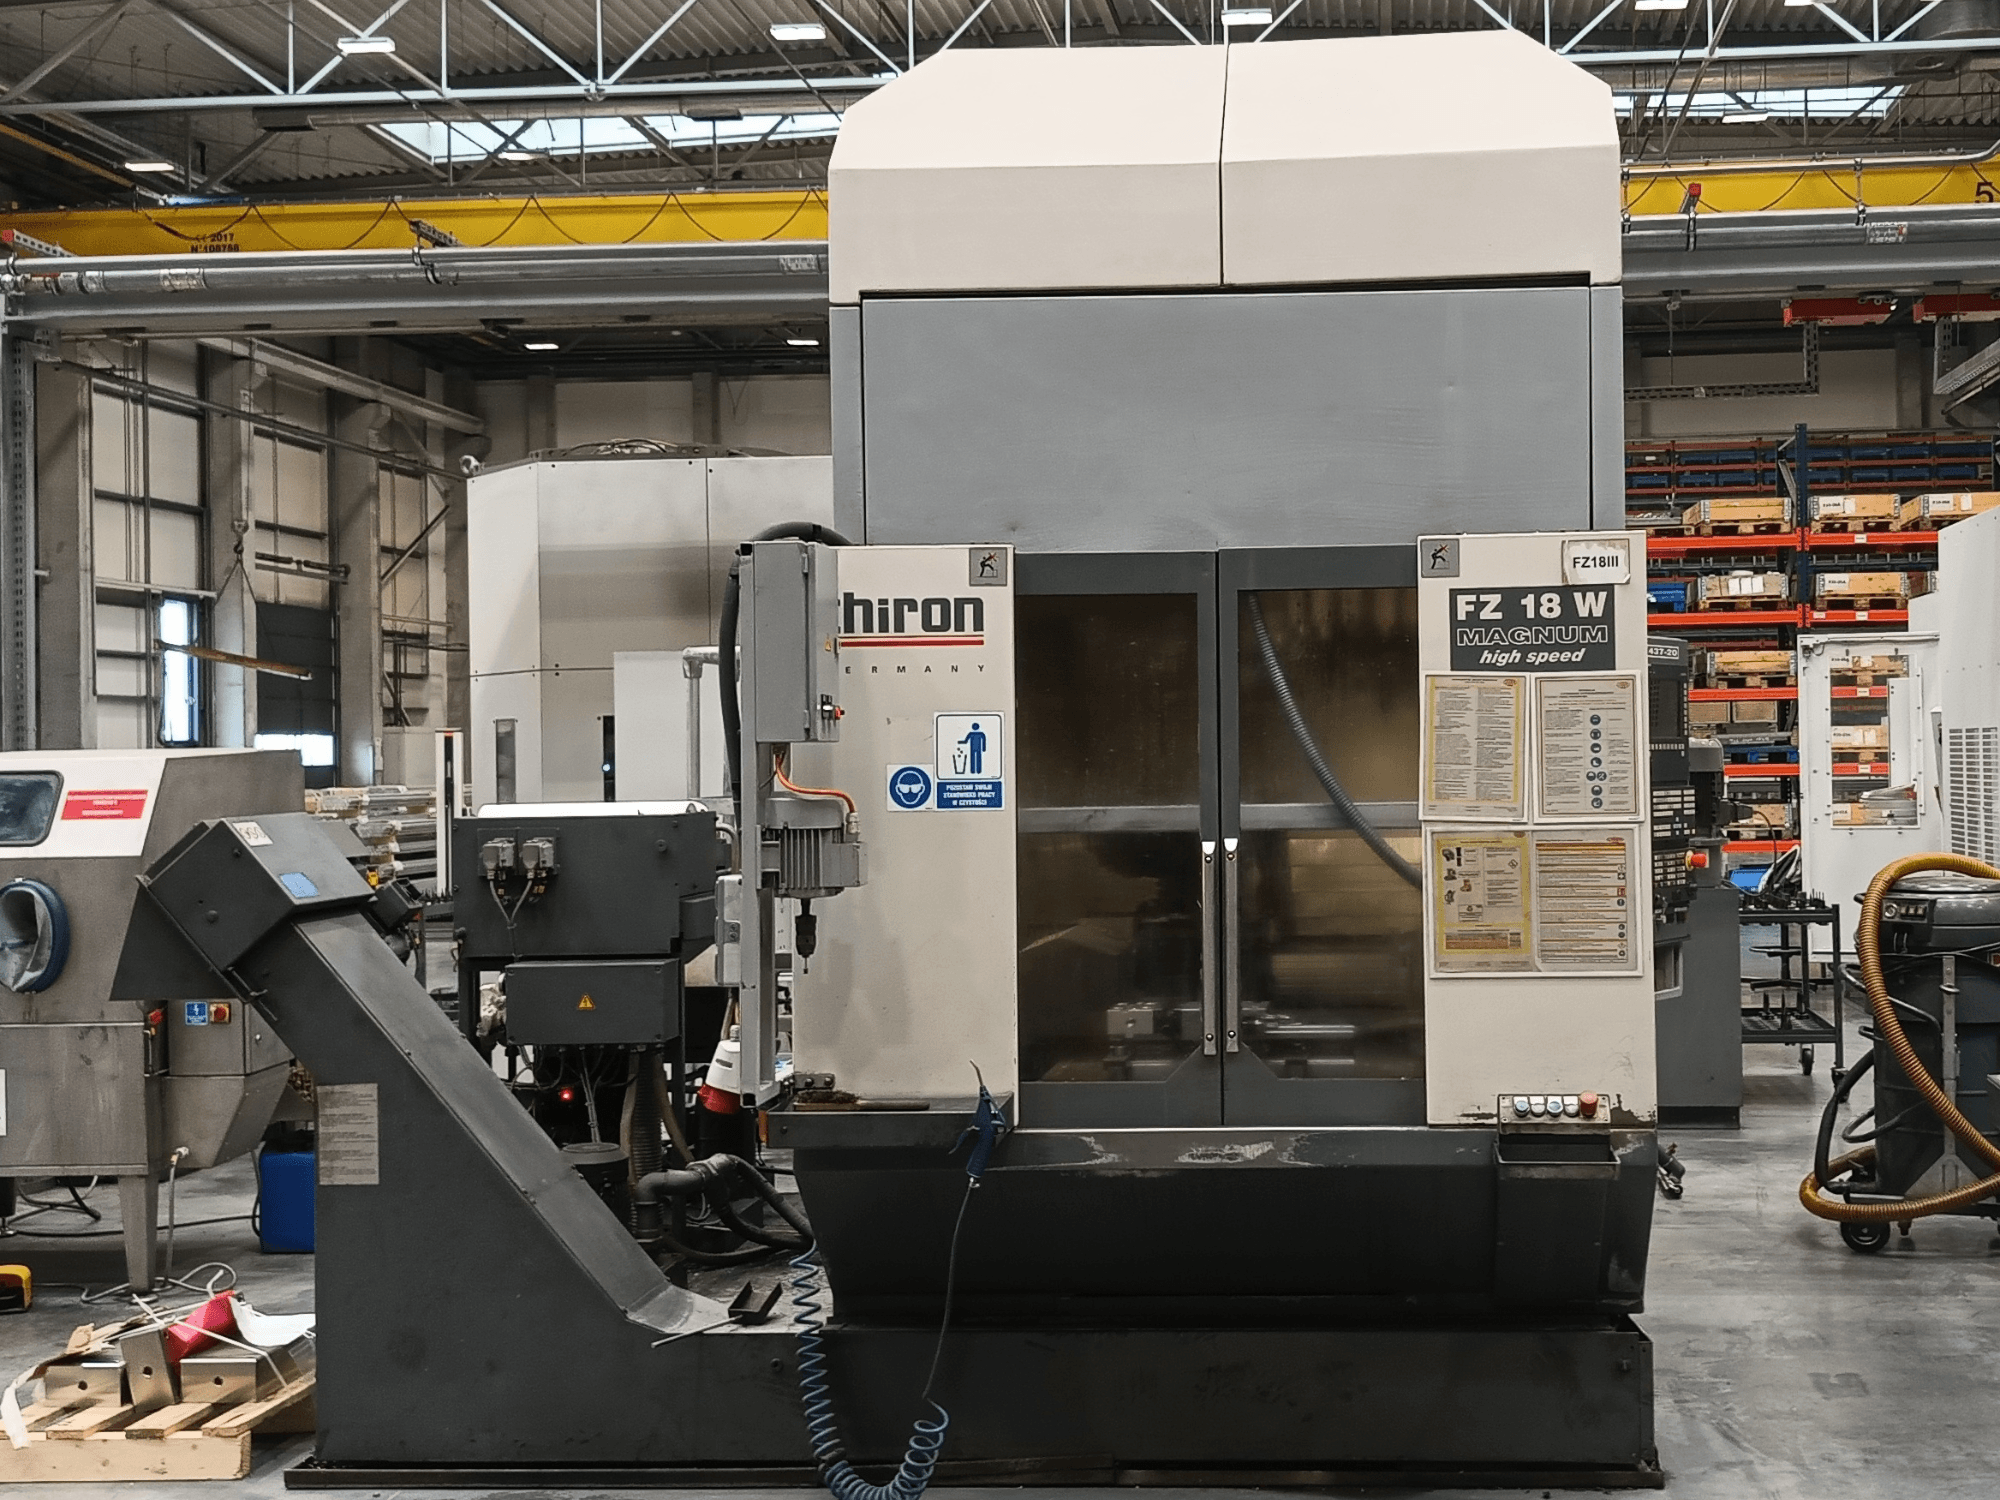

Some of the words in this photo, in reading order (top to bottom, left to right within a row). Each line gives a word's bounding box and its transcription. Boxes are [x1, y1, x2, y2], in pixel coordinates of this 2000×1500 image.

[1975, 182, 1994, 203] 5
[210, 233, 235, 243] 2017
[1573, 556, 1619, 569] FZ18III
[838, 592, 984, 634] hiron
[1456, 593, 1503, 621] FZ
[1520, 592, 1562, 619] 18
[1573, 591, 1608, 618] W
[1456, 625, 1608, 646] MAGNUM
[1479, 649, 1524, 666] high
[1526, 648, 1585, 665] speed
[1648, 648, 1678, 656] 437-20
[845, 665, 984, 674] ERMANY
